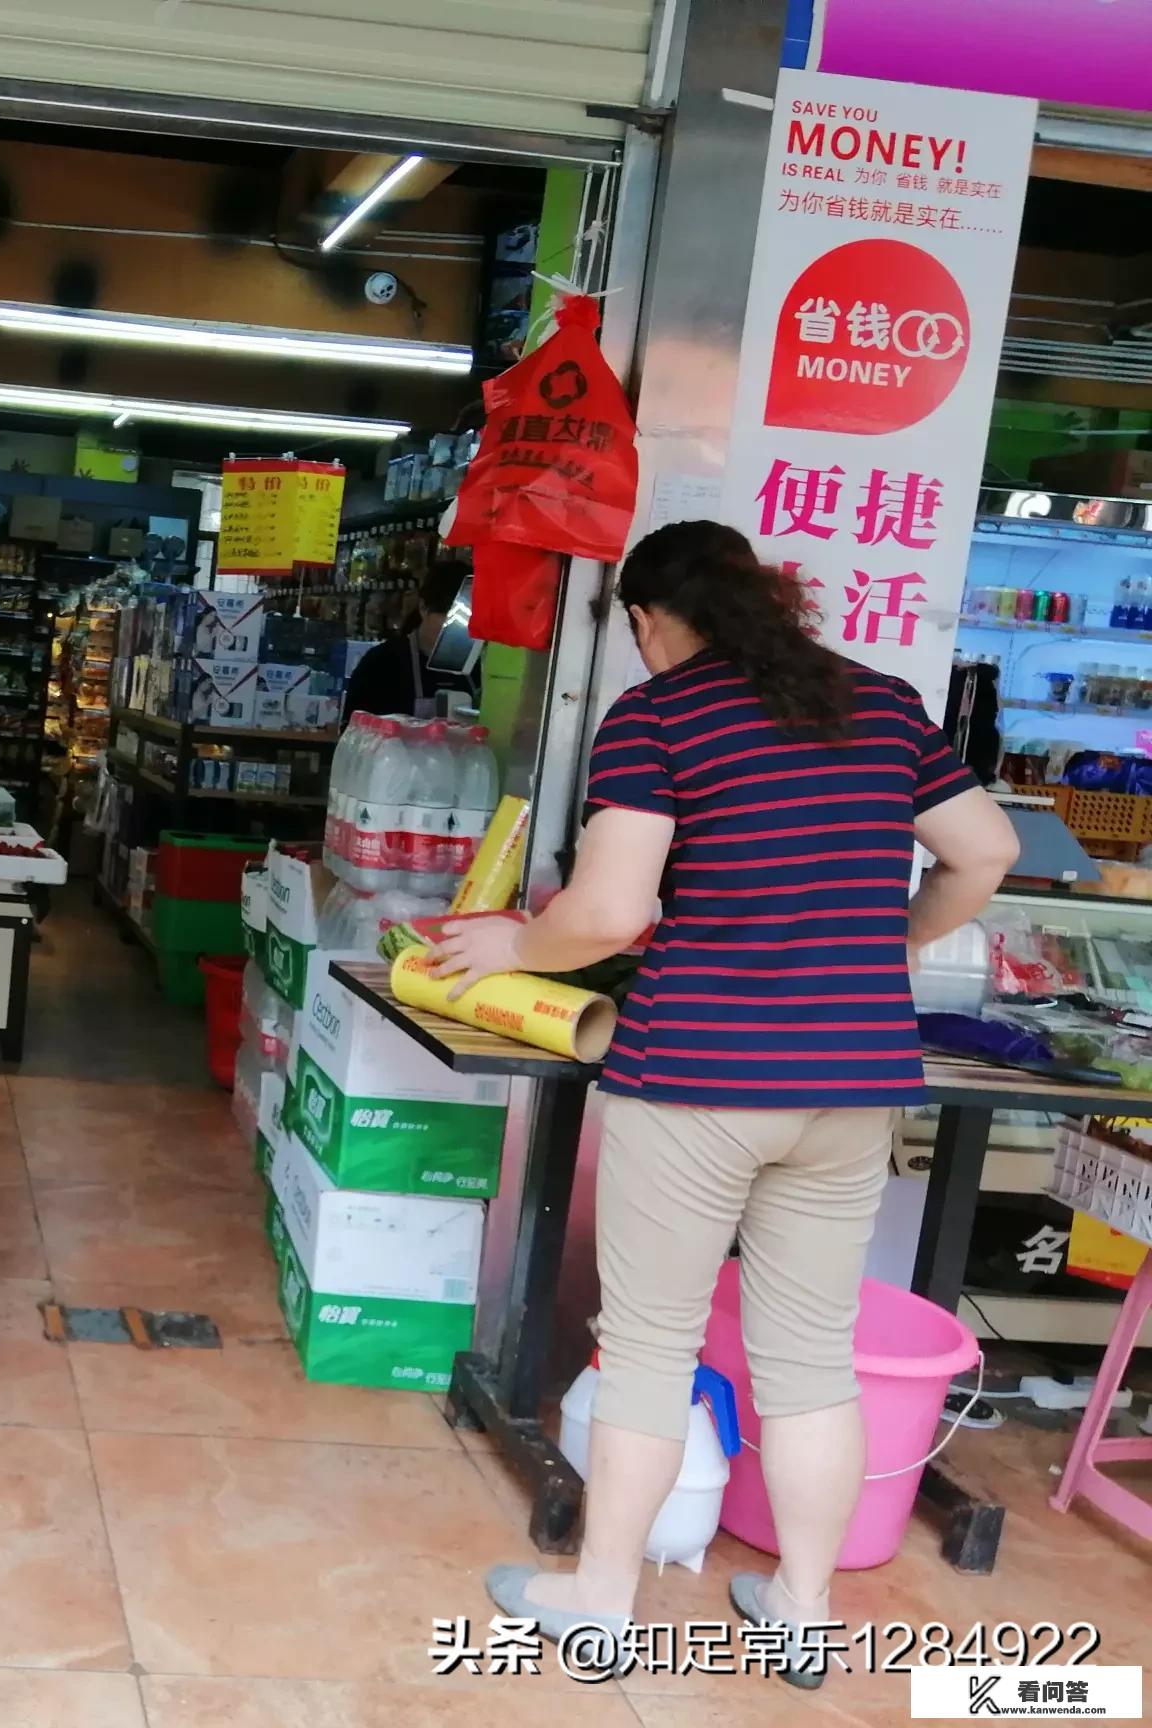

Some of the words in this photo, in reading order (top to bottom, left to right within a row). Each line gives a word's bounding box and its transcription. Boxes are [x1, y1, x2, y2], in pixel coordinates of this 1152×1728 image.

[792, 100, 837, 118] SAVE
[842, 106, 878, 123] YOU
[787, 120, 966, 174] MONEY!
[782, 162, 798, 177] IS
[802, 164, 844, 182] REAL
[854, 168, 887, 186] 为你
[895, 172, 928, 191] 省钱
[937, 177, 1003, 199] 就是实在
[794, 296, 891, 351] 省钱
[796, 354, 912, 388] MONEY
[755, 458, 944, 549] 便捷
[1016, 1224, 1071, 1275] 名
